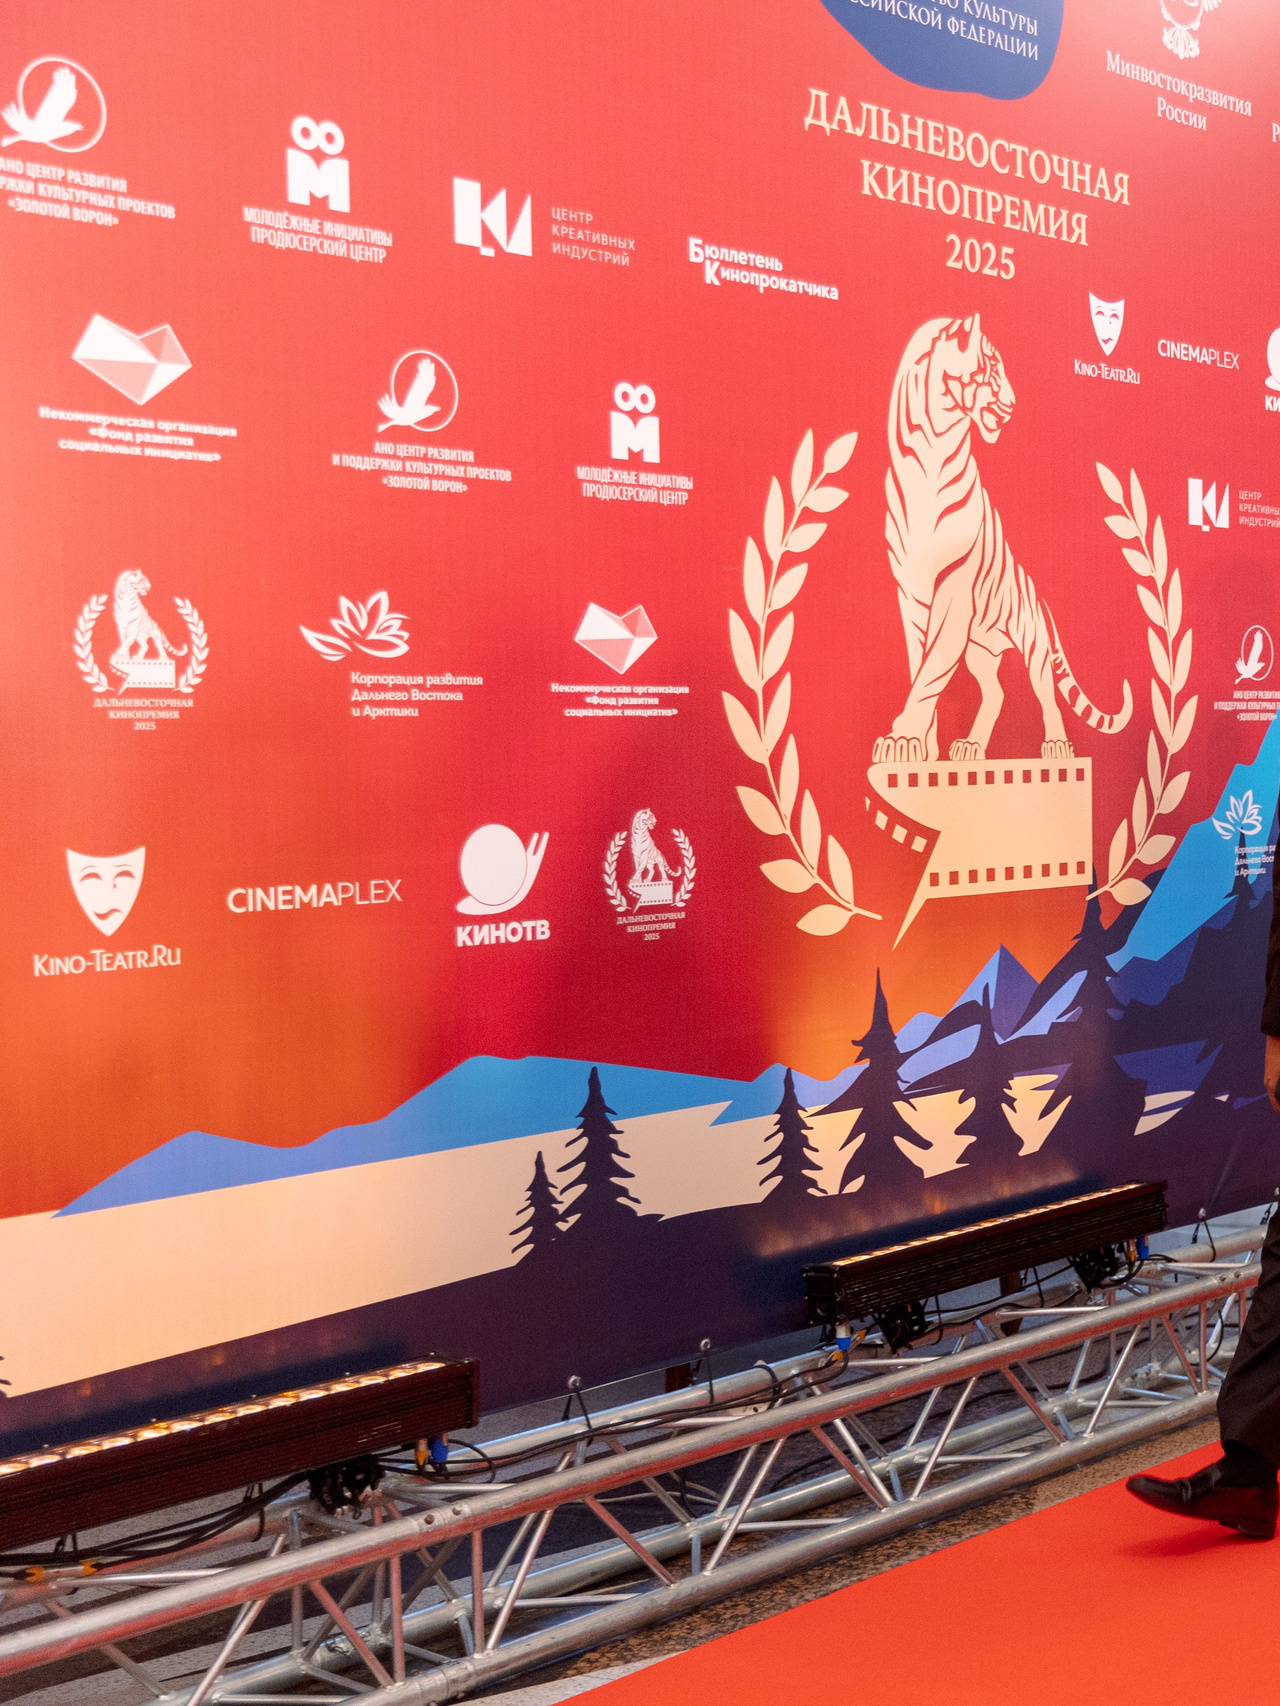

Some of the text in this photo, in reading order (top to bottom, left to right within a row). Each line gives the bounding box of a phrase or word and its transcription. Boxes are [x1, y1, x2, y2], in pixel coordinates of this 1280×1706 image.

[964, 0, 1038, 36] КУЛЬТУРЫ
[947, 17, 1039, 60] ФЕДЕРАЦИИ
[1106, 51, 1252, 116] Минвостокразвития
[1157, 97, 1207, 130] России
[804, 88, 1131, 205] ДАЛЬНЕВОСТОЧНАЯ
[26, 162, 65, 181] ЦЕНТР
[67, 169, 128, 193] РАЗВИТИЯ
[8, 197, 119, 226] «ЗОЛОТОЙ ВОРОН»
[37, 182, 116, 209] КУЛЬТУРНЫХ
[117, 196, 175, 219] ПРОЕКТОВ
[860, 160, 1088, 246] КИНОПРЕМИЯ
[243, 206, 393, 247] МОЛОДЁЖНЫЕ ИНИЦИАТИВЫ
[551, 206, 593, 224] ЦЕНТР
[251, 226, 387, 264] ПРОДЮСЕРСКИЙ ЦЕНТР
[551, 225, 635, 251] КРЕАТИВНЫХ
[552, 242, 630, 267] ИНДУСТРИЙ
[689, 237, 783, 271] Бюллетень
[946, 234, 1015, 280] 2025
[704, 259, 839, 300] Кинопрокатчика
[1157, 339, 1240, 371] CINEMAPLEX
[39, 406, 237, 437] Некоммерческая организация
[89, 427, 194, 447] «Фонд развития
[58, 438, 221, 462] социальных инициатив»
[374, 442, 474, 463] АНО ЦЕНТР РАЗВИТИЯ
[333, 454, 512, 482] И ПОДДЕРЖКИ КУЛЬТУРНЫХ ПРОЕКТОВ
[577, 466, 694, 490] МОЛОДЁЖНЫЕ ИНИЦИАТИВЫ
[382, 475, 468, 493] «ЗОЛОТОЙ ВОРОН»
[583, 482, 688, 506] ПРОДЮСЕРСКИЙ ЦЕНТР
[1239, 490, 1262, 500] ЦЕНТР
[1239, 516, 1280, 528] ИНДУСТРИЙ
[351, 672, 483, 688] Корпорация развития
[551, 683, 689, 695] Некоммерческая организация
[93, 698, 194, 708] ДАЛЬНЕВОСТОЧНАЯ
[351, 688, 464, 701] Дальнего Востока
[586, 695, 659, 706] «Фонд развития
[109, 710, 180, 719] КИНОПРЕМИЯ
[352, 705, 419, 720] и Арктики
[565, 708, 678, 718] социальных инициатив»
[134, 721, 156, 731] 2025
[227, 879, 403, 913] CINEMAPLEX
[616, 911, 686, 925] ДАЛЬНЕВОСТОЧНАЯ
[627, 922, 676, 933] КИНОПРЕМИЯ
[456, 919, 551, 948] КИНОТВ
